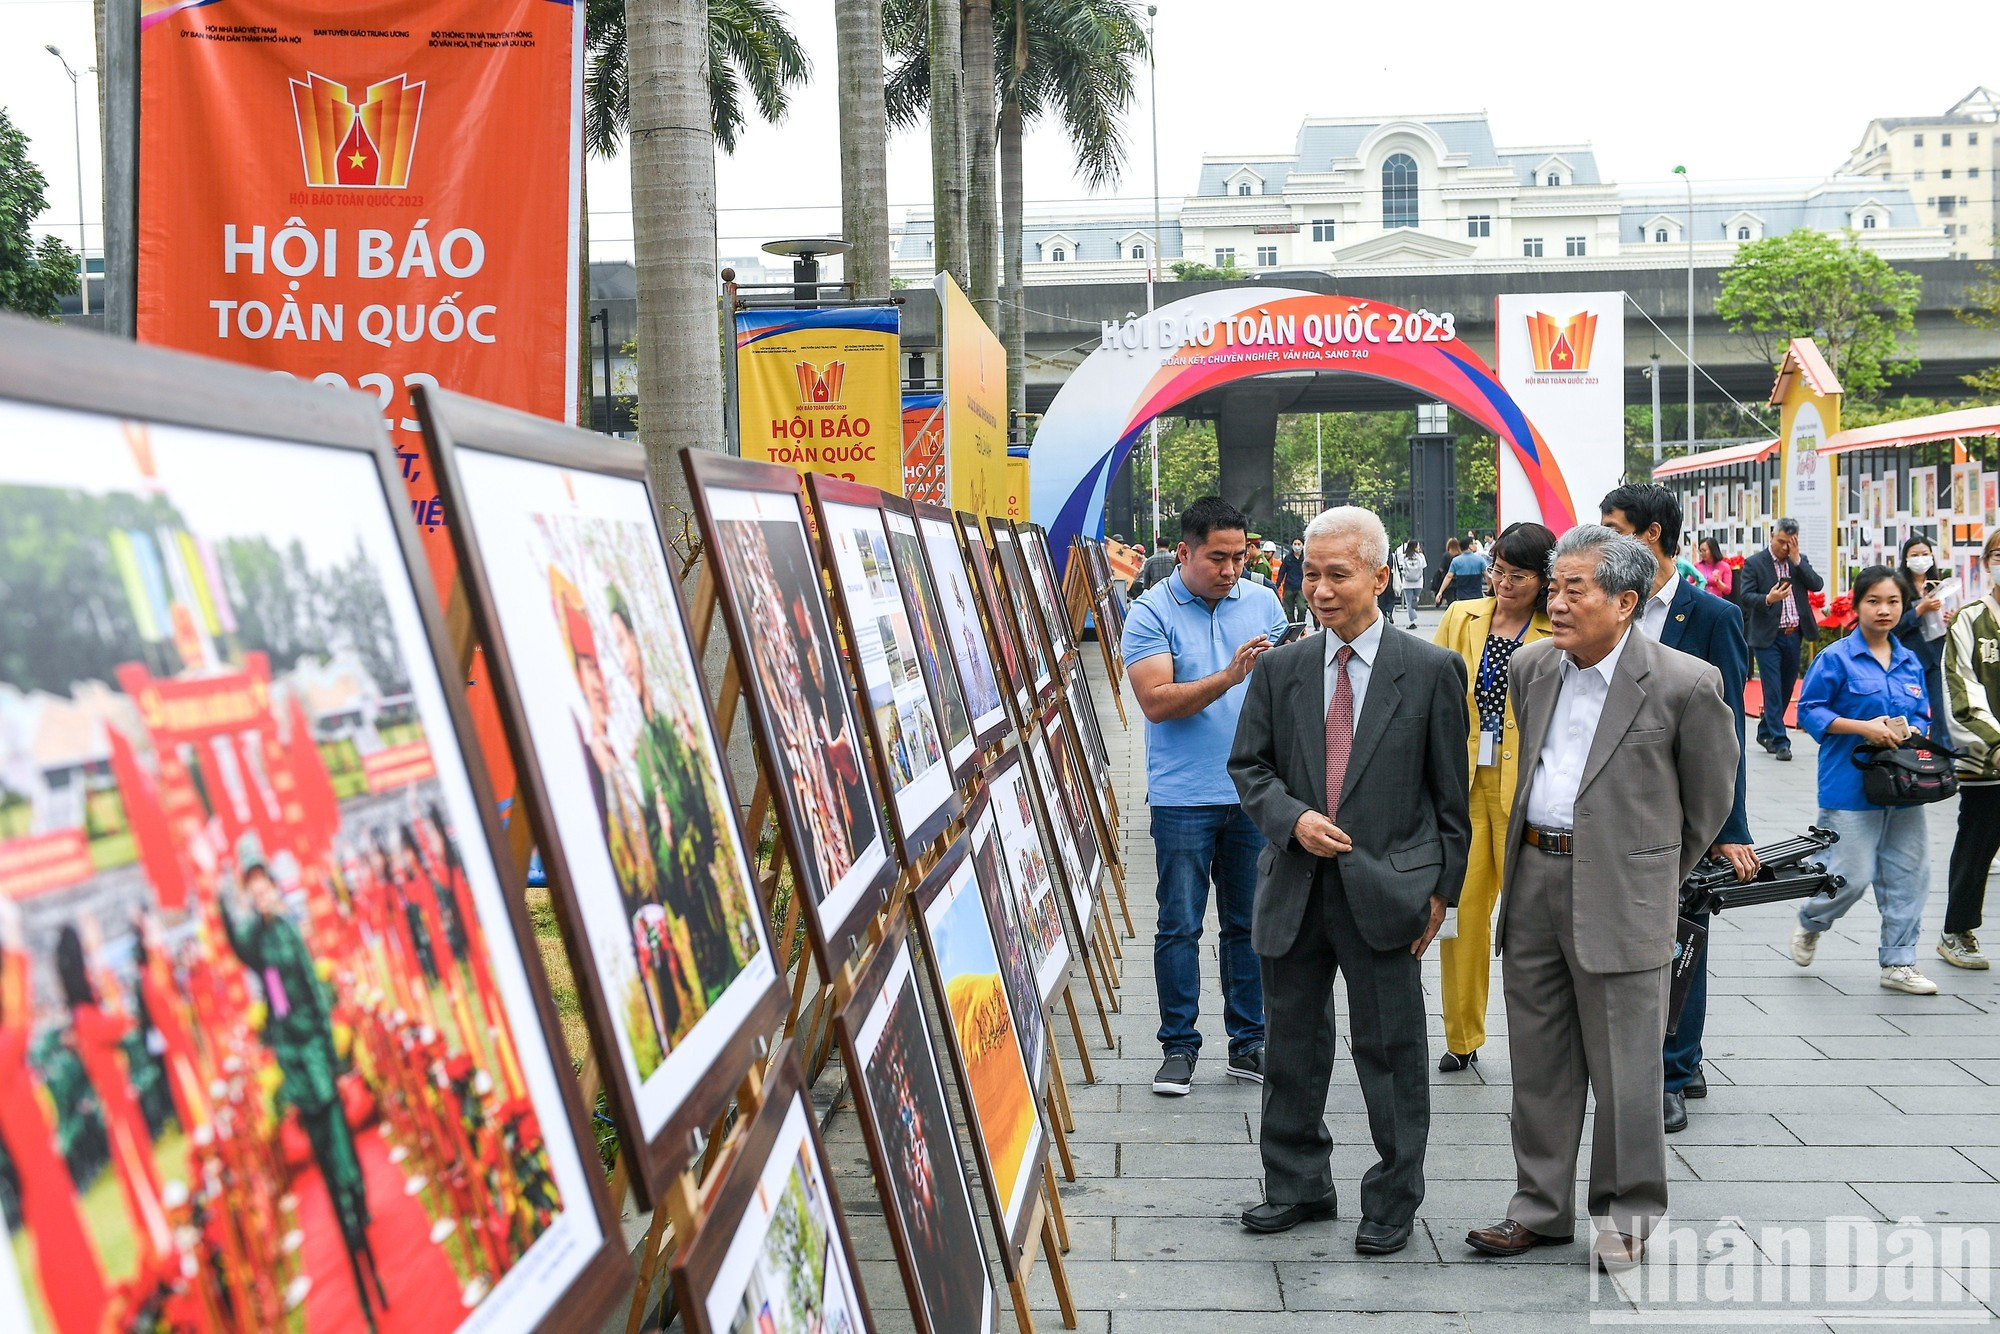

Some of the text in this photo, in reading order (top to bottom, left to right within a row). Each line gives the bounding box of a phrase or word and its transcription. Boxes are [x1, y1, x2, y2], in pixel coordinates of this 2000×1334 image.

[289, 191, 424, 208] HỘI BÁO TOÀN QUỐC 2023
[224, 216, 486, 291] HỘI BÁO
[209, 291, 497, 348] TOÀN QUỐC
[1101, 302, 1458, 357] HỘI BÁO TOÀN QUỐC 2023
[1188, 354, 1206, 366] KẾT,
[1207, 352, 1244, 364] CHUYÊN
[1244, 350, 1280, 363] NGHIỆP,
[1282, 348, 1300, 360] VĂN
[1351, 349, 1369, 360] TẠO
[1525, 376, 1536, 386] HỘI
[1537, 376, 1550, 384] BÁO
[1550, 376, 1566, 384] TOÀN
[772, 414, 870, 444] HỘI BÁO
[768, 442, 876, 464] TOÀN QUỐC
